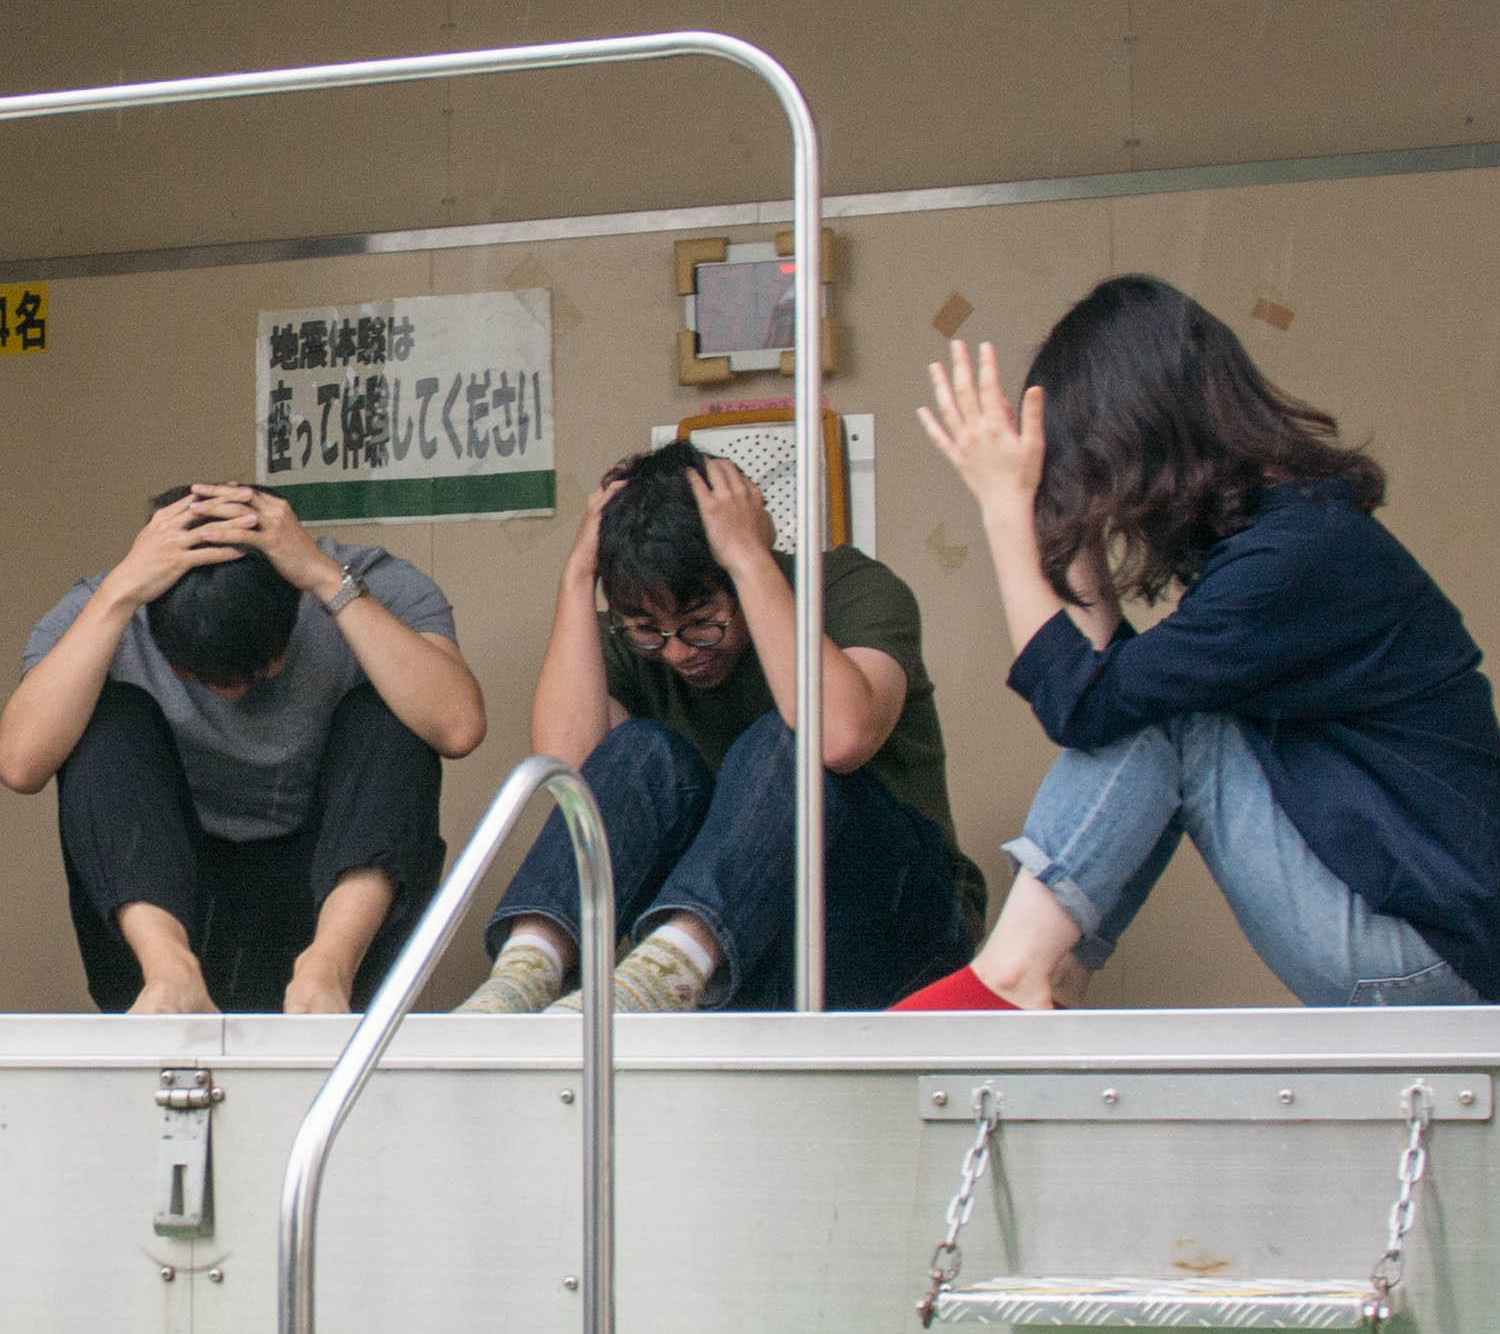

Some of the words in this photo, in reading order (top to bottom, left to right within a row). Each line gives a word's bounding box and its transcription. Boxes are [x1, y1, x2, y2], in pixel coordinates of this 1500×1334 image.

[269, 316, 416, 372] 地震体験は
[267, 367, 544, 476] 座って体験してください
